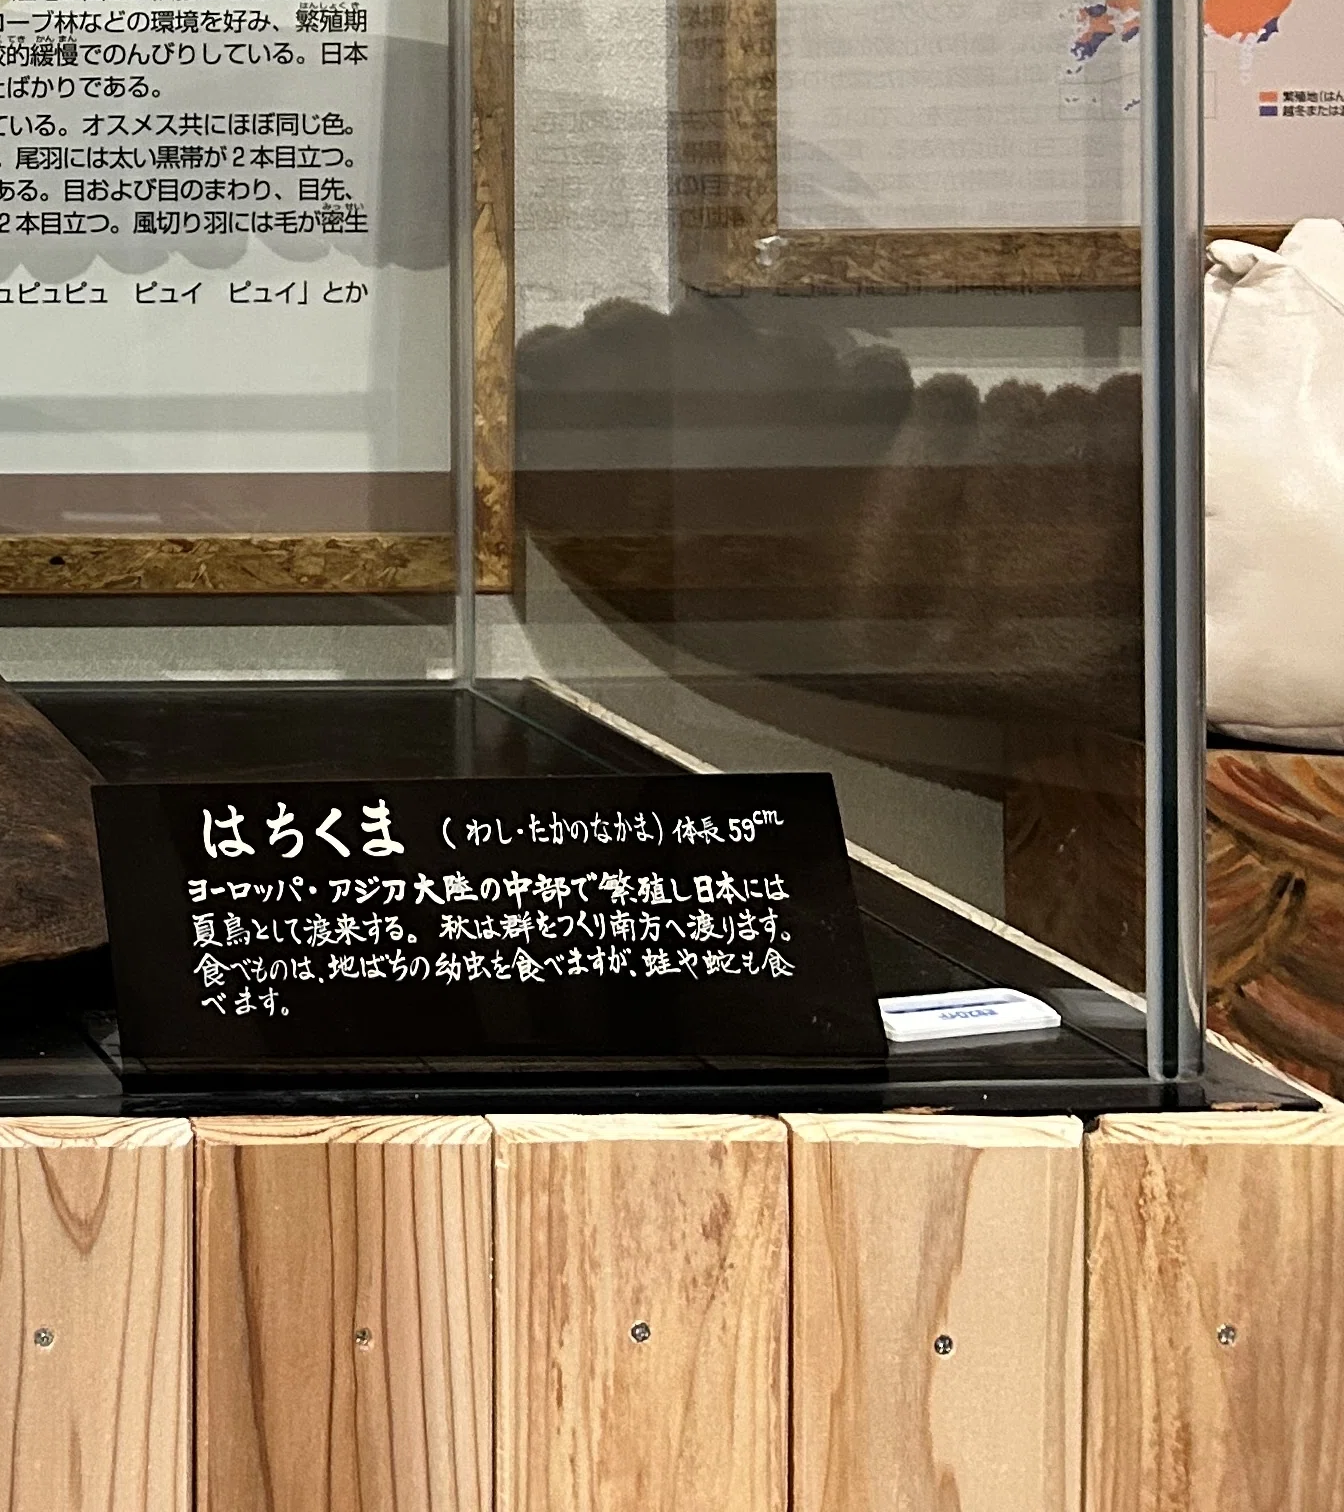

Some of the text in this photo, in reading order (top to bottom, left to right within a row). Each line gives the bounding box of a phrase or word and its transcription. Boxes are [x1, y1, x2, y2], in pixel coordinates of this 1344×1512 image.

[203, 798, 405, 858] はちくま
[201, 986, 290, 1017] べます。
